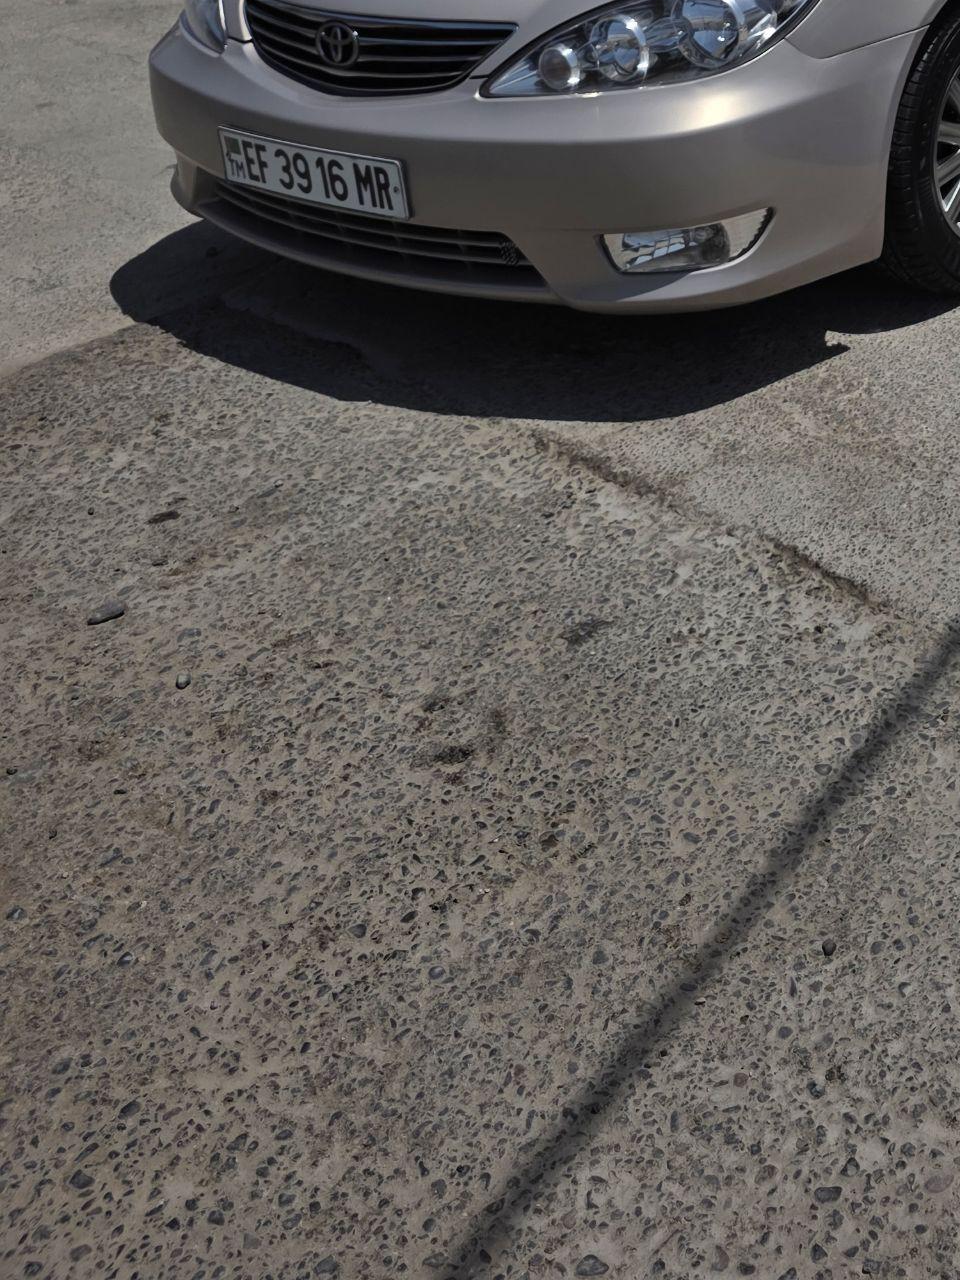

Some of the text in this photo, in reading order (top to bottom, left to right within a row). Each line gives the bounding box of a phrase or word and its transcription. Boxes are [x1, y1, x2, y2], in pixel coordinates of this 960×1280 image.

[228, 140, 394, 211] TM EF 3916 MR
